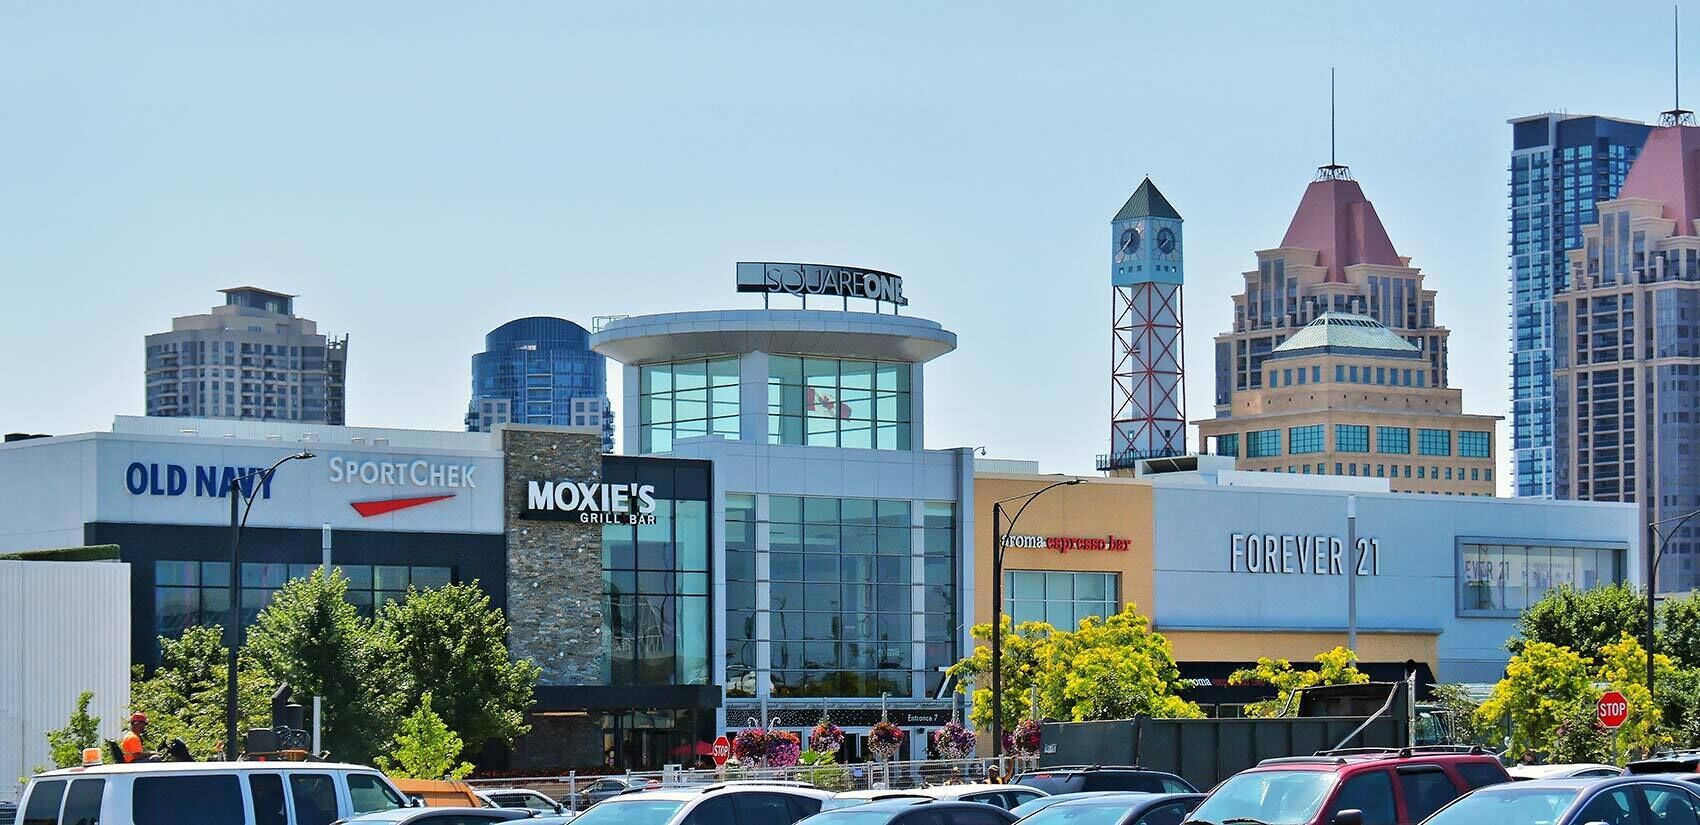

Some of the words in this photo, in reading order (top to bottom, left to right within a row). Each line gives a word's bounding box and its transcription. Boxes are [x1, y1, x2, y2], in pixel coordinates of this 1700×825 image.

[125, 462, 187, 496] OLD
[194, 466, 276, 499] NAVY
[528, 480, 656, 513] MOXIE'S
[580, 512, 620, 523] GRILL
[629, 514, 656, 525] BAR
[1001, 534, 1044, 549] aroma
[1045, 536, 1105, 553] espresso
[1108, 535, 1132, 551] bar
[1231, 533, 1344, 575] FOREVER
[1356, 537, 1380, 576] 21
[907, 713, 932, 722] Entrance
[933, 713, 938, 721] 7
[1600, 702, 1626, 717] STOP
[714, 744, 728, 757] STOP
